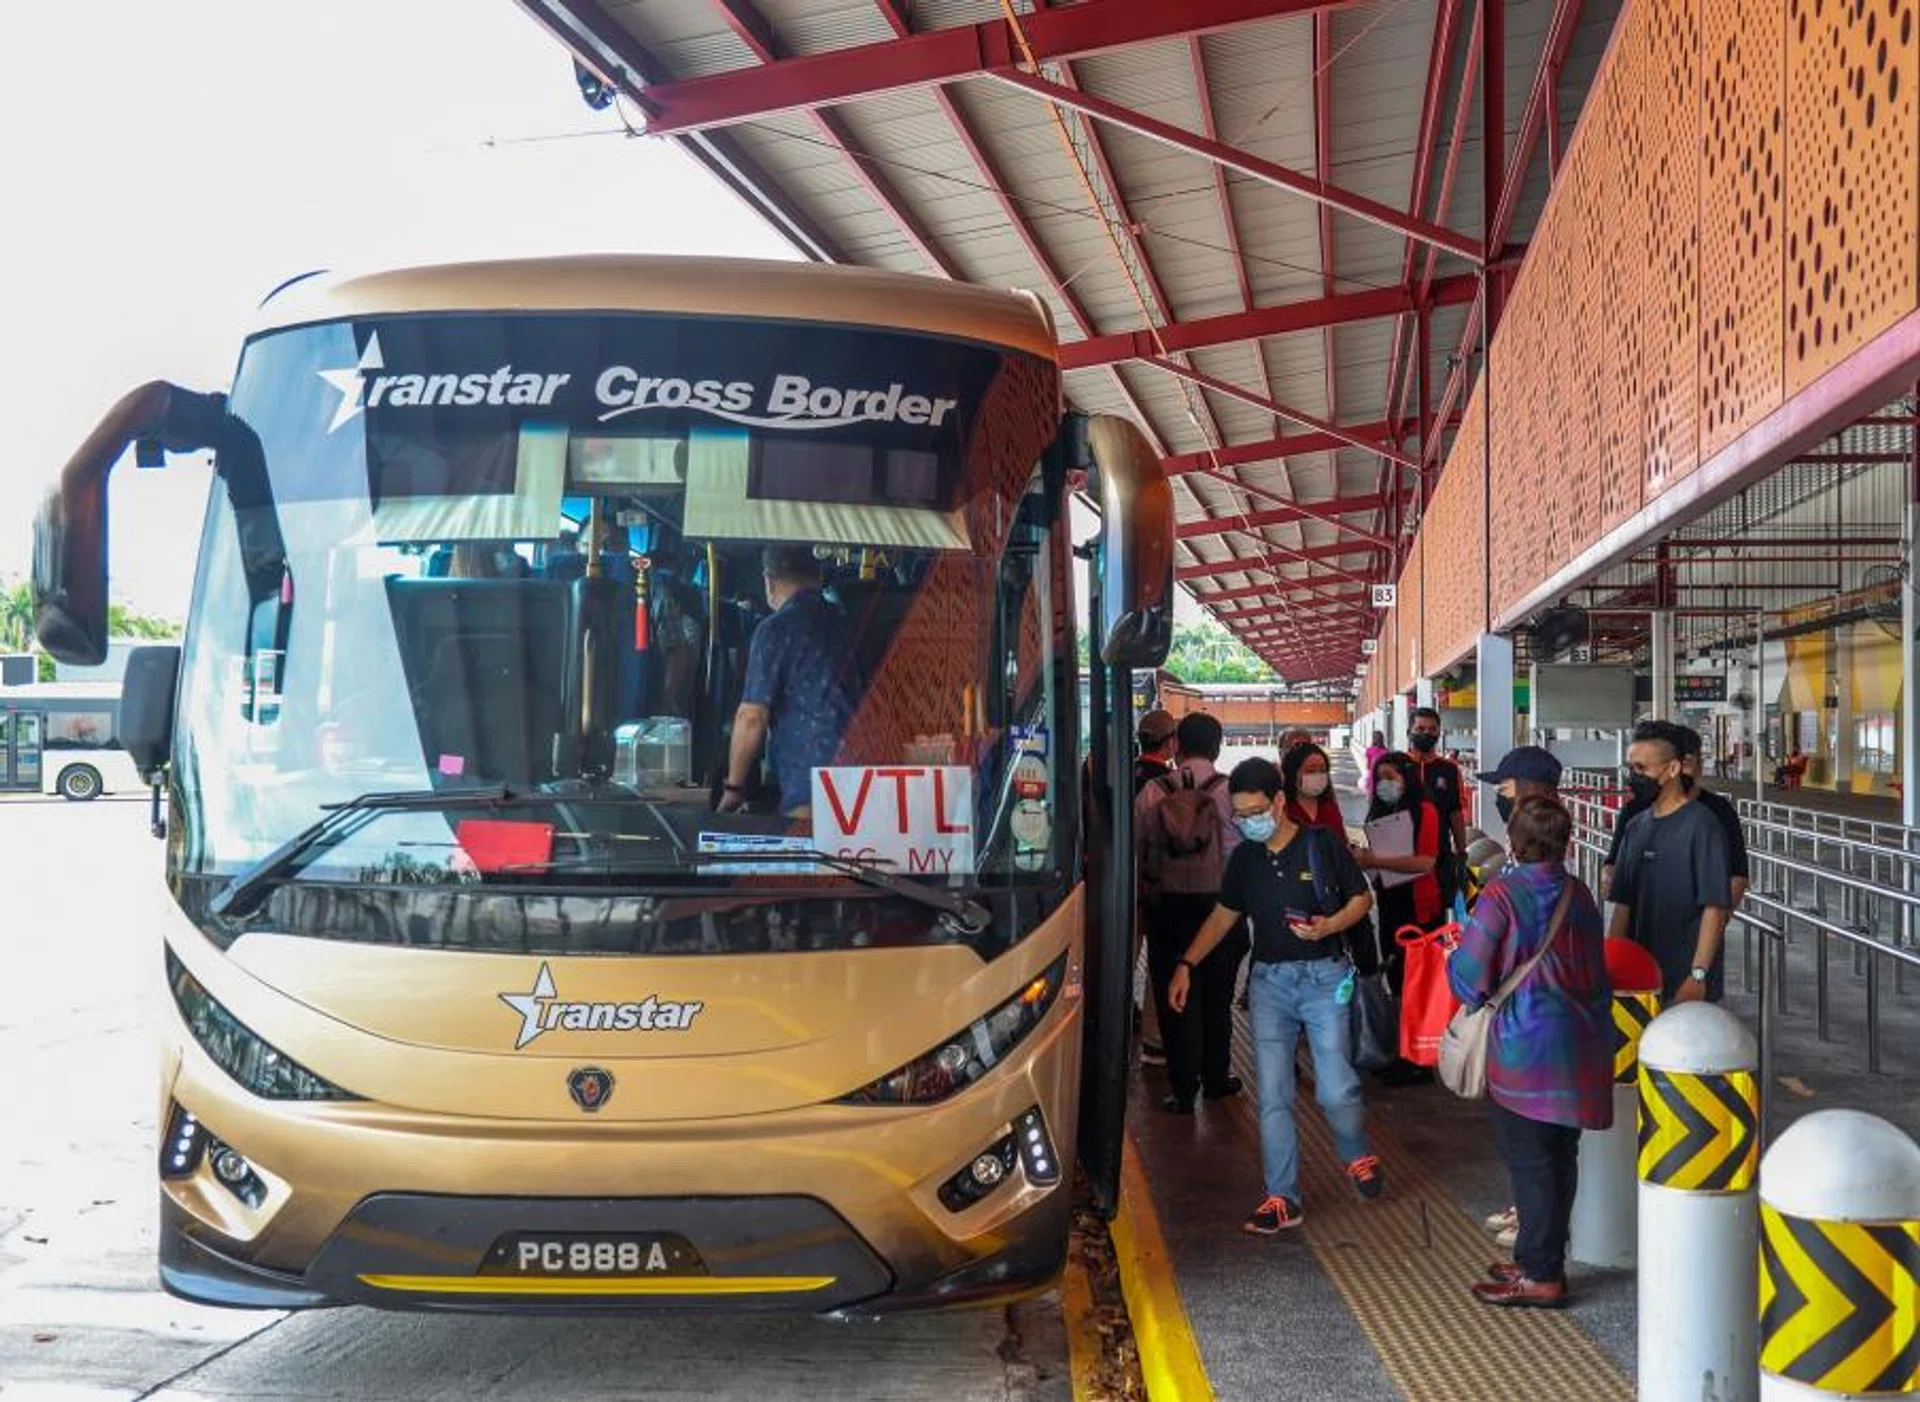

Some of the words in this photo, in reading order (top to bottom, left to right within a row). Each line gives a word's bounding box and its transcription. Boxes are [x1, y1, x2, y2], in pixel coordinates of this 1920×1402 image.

[317, 329, 571, 434] Transtar
[595, 366, 754, 411] Cross
[767, 374, 957, 427] Border
[1375, 589, 1392, 602] B3
[819, 769, 970, 835] VTL
[909, 848, 955, 872] MY
[498, 961, 704, 1050] Transtar
